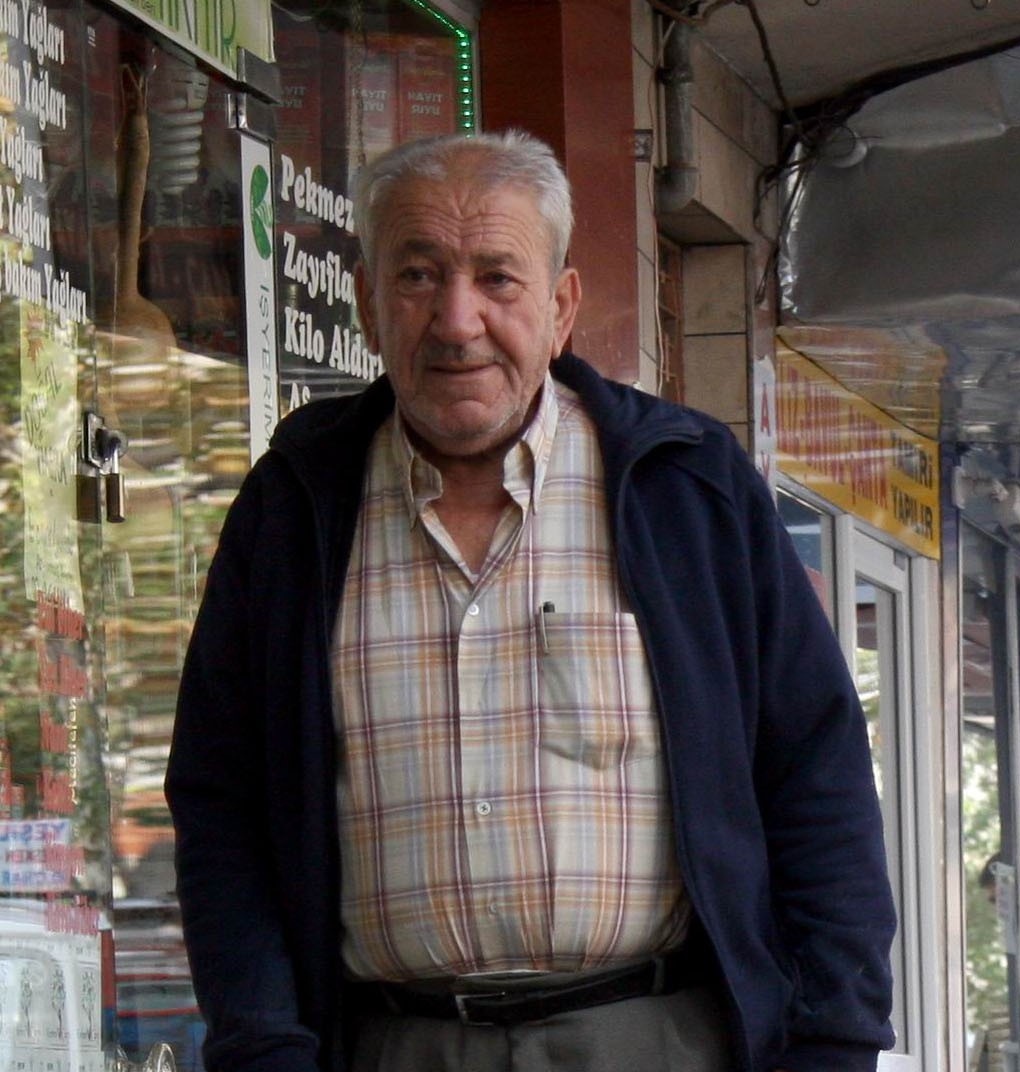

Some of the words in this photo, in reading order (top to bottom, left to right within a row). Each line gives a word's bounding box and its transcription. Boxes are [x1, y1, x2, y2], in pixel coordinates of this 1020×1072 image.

[23, 0, 64, 65] Yağları
[23, 60, 66, 131] Yağları
[7, 185, 50, 251] Yağları
[44, 263, 86, 329] Yağları
[284, 231, 357, 307] Zayıfla
[285, 306, 324, 363] Kilo
